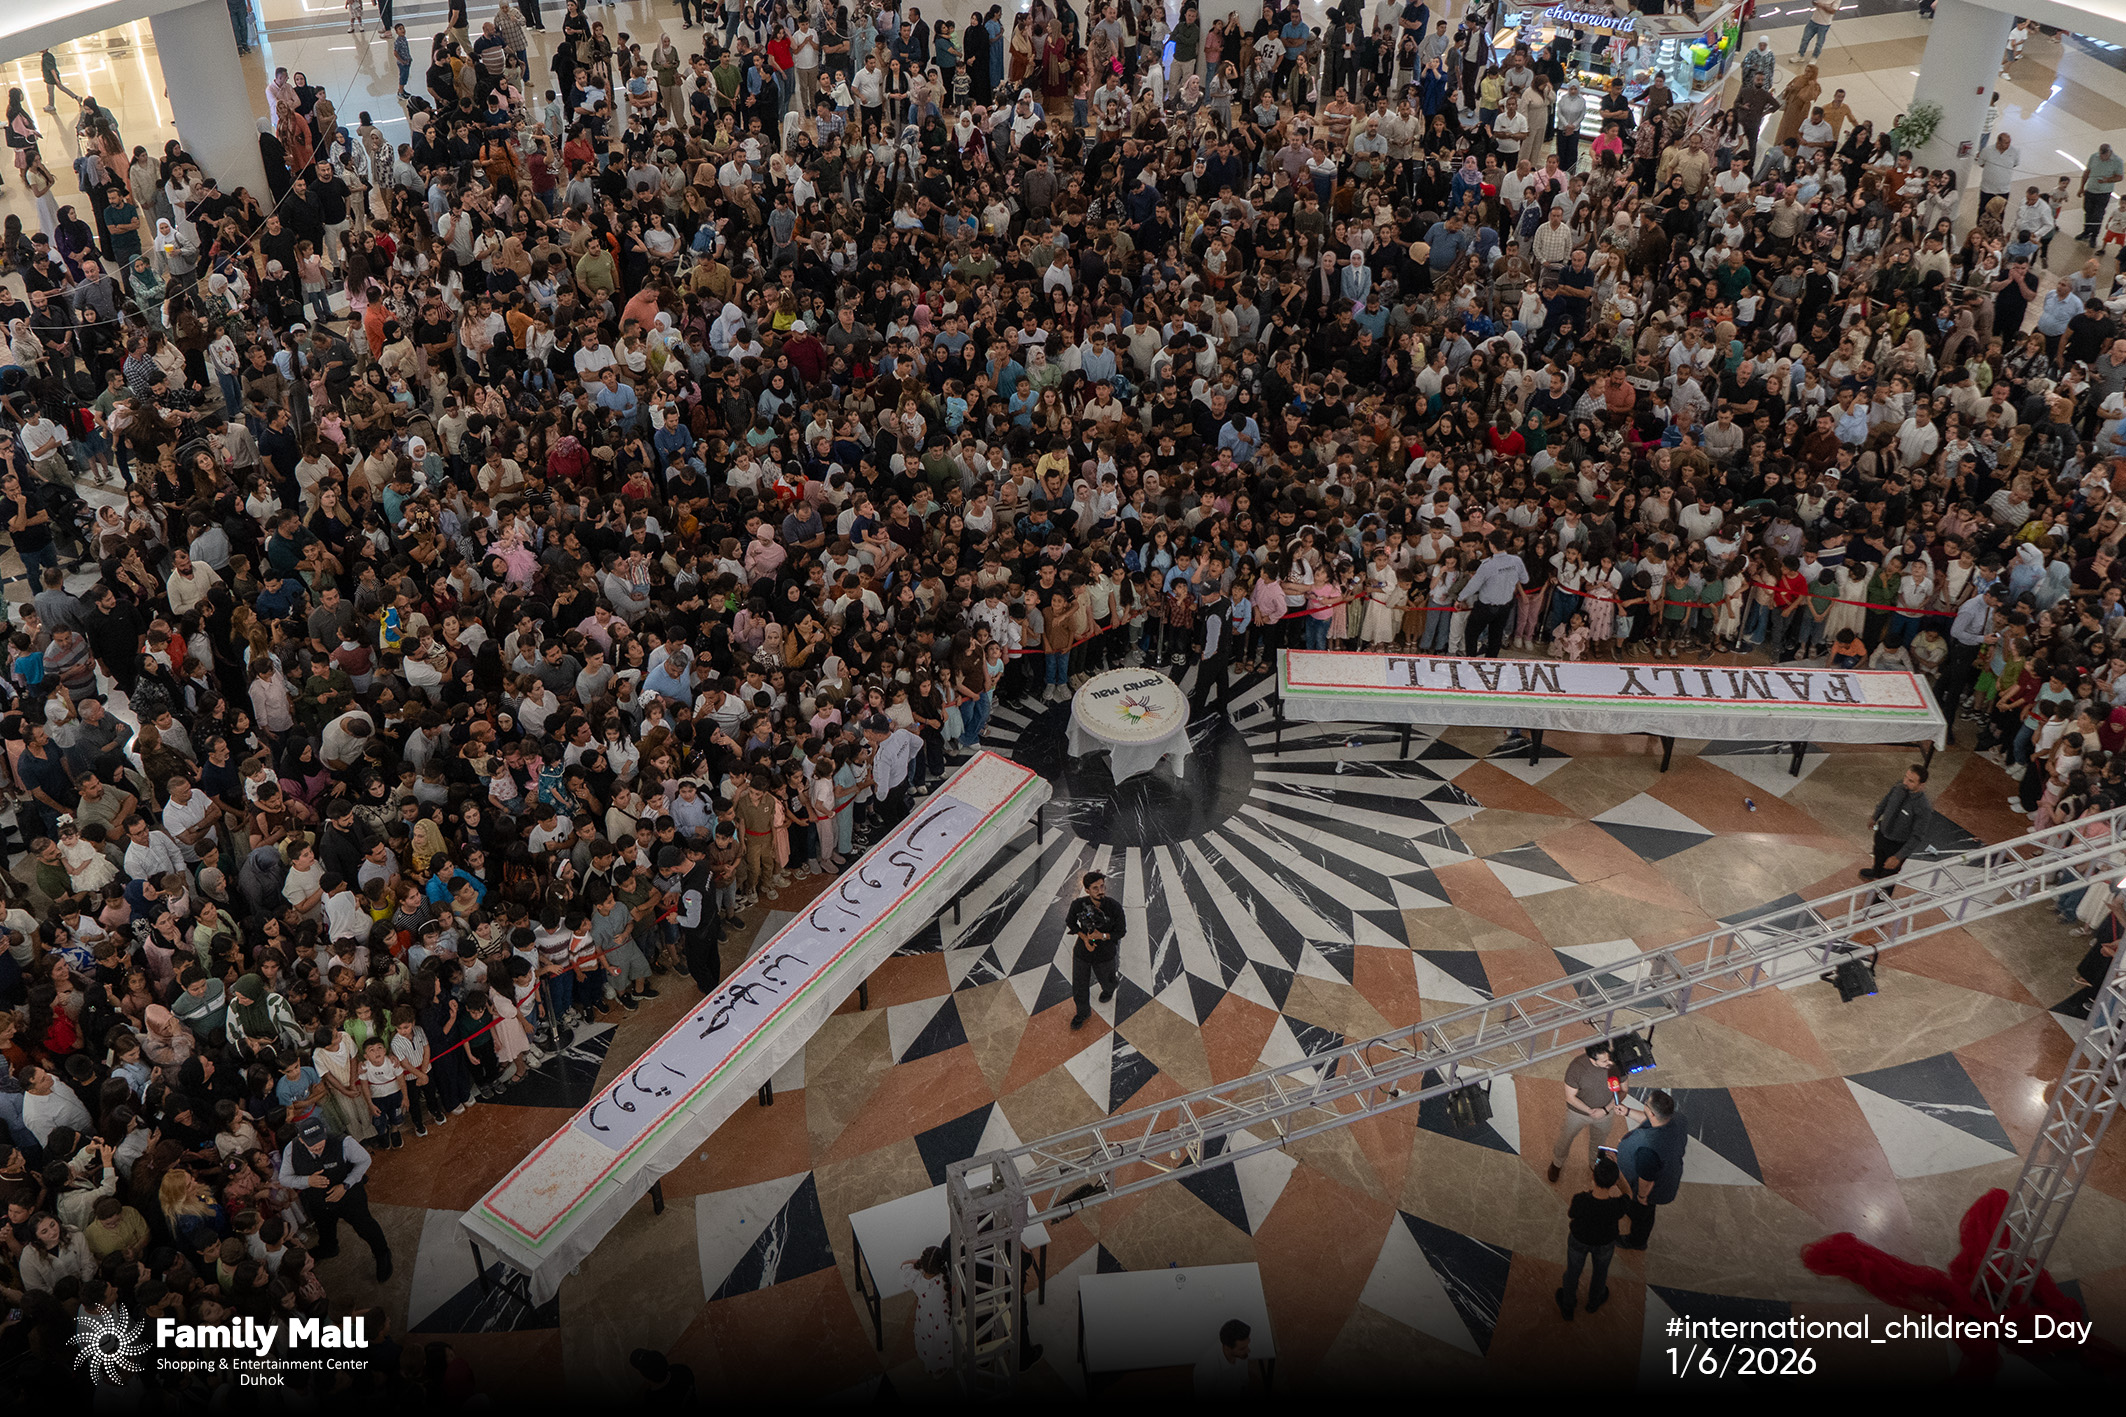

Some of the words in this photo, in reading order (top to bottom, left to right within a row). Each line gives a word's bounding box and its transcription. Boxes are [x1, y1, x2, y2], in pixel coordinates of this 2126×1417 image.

[1544, 3, 1637, 32] chocoworld
[1388, 657, 1566, 693] MALL
[1617, 667, 1860, 704] FAMILY
